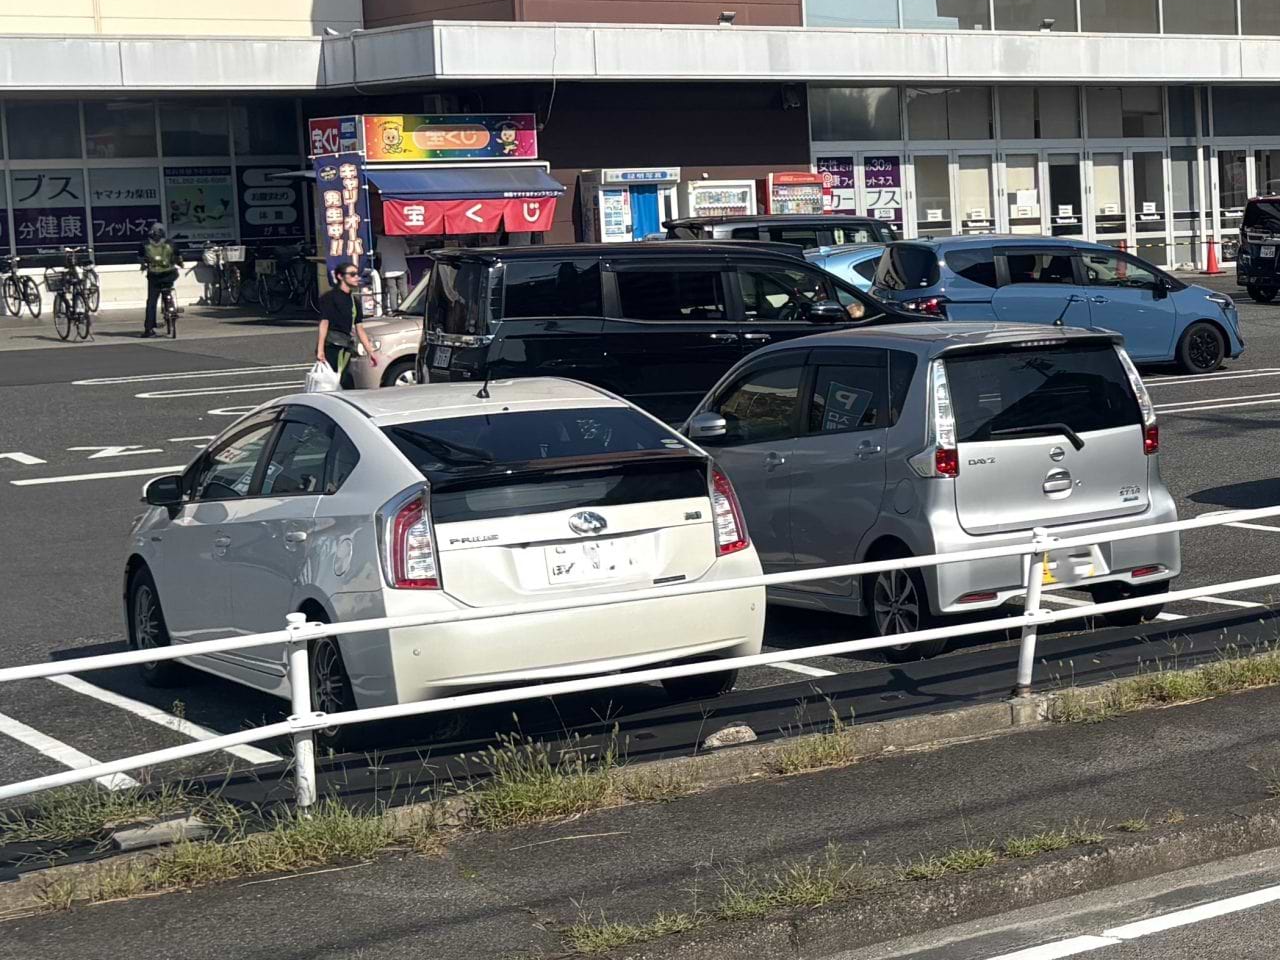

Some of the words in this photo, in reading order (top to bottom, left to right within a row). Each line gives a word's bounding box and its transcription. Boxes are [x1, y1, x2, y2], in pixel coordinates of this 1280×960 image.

[312, 128, 339, 154] 宝くじ
[425, 129, 478, 146] 宝くじ
[14, 174, 80, 202] ブス
[93, 189, 157, 200] ヤマナカ柴田
[403, 203, 541, 226] 宝くじ
[19, 215, 83, 240] 分健康
